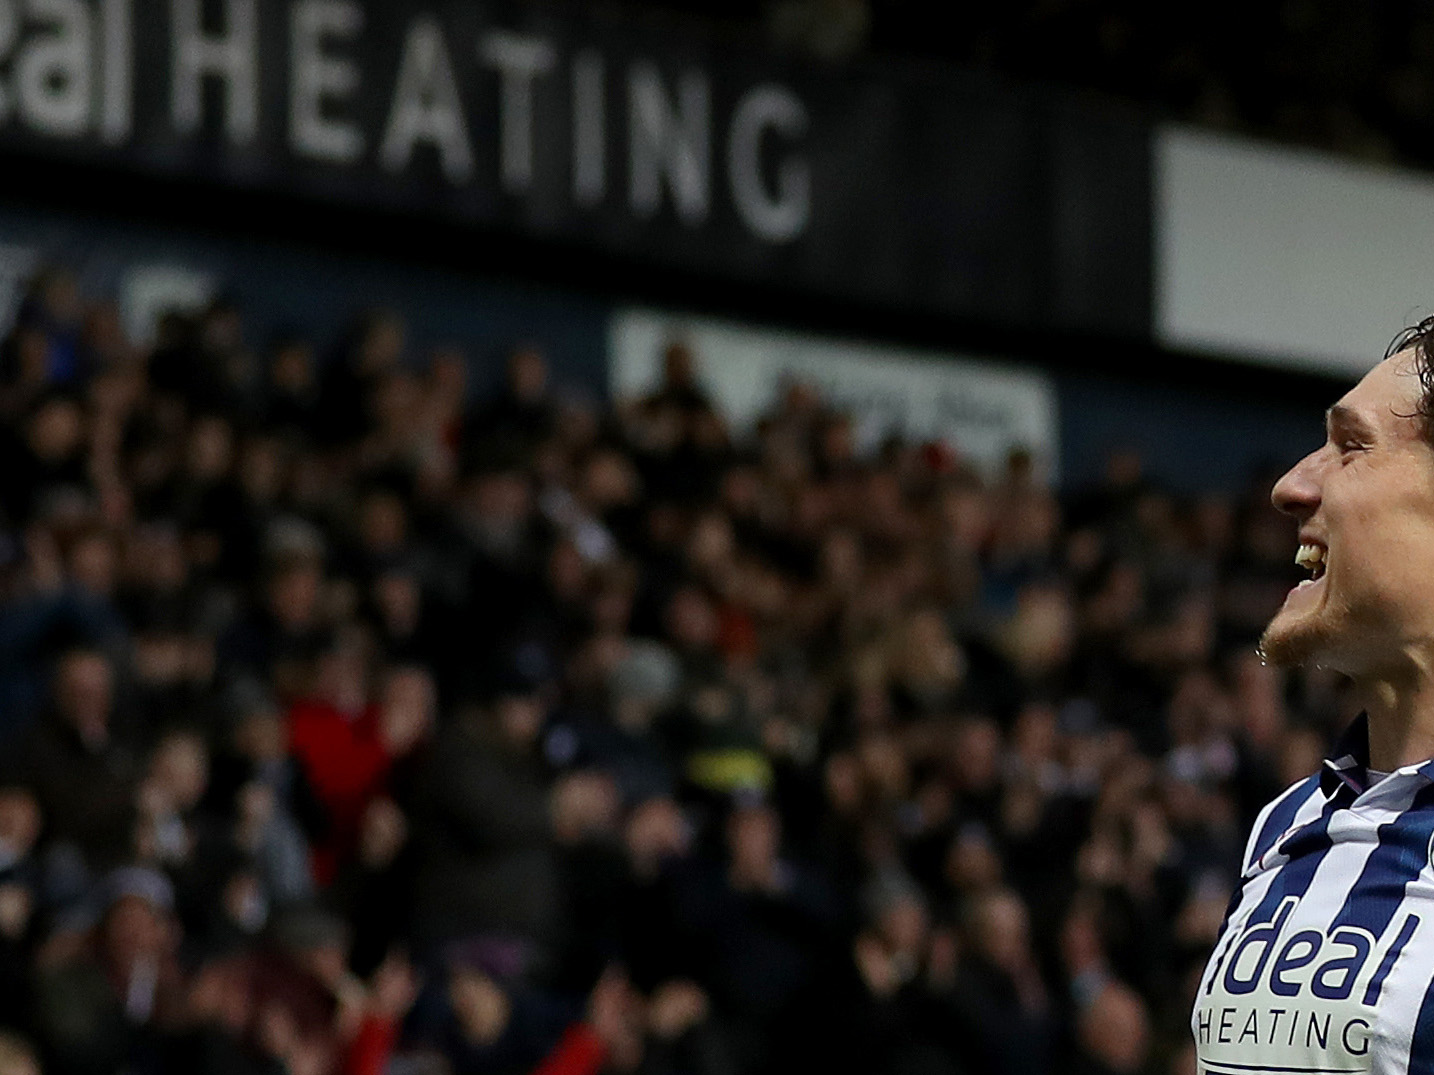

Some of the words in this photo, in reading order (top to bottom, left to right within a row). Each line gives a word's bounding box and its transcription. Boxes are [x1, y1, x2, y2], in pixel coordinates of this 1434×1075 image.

[0, 0, 131, 145] al
[165, 0, 814, 242] HEATING
[1206, 900, 1420, 1007] ideal
[1199, 1007, 1370, 1056] HEATING
